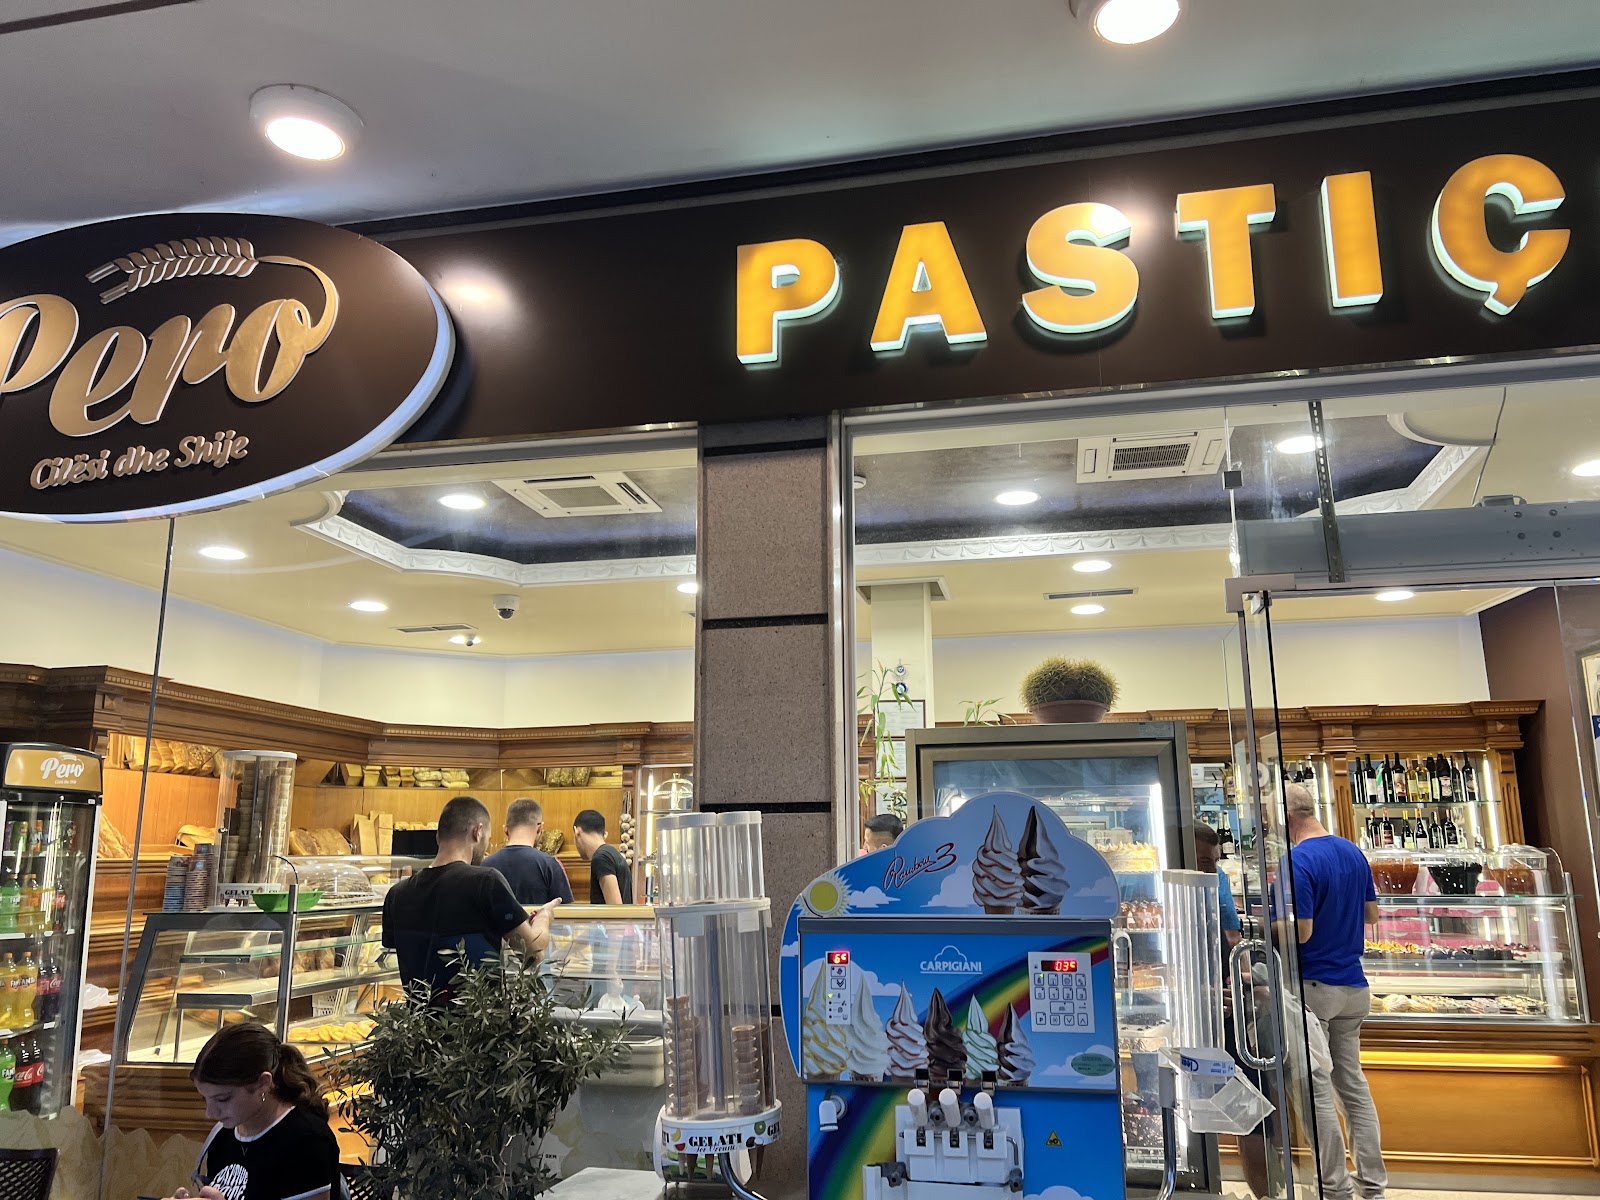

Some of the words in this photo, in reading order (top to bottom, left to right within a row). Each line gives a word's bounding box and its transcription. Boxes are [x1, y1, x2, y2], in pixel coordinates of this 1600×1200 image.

[0, 293, 339, 437] Pero
[30, 449, 111, 490] Cilësi
[113, 445, 170, 477] dhe
[174, 429, 249, 468] Shije
[40, 757, 85, 780] Pero
[883, 856, 937, 890] Rainbow
[924, 842, 957, 872] 3
[920, 960, 982, 972] CARPIGIANI
[688, 1133, 742, 1147] GELATI
